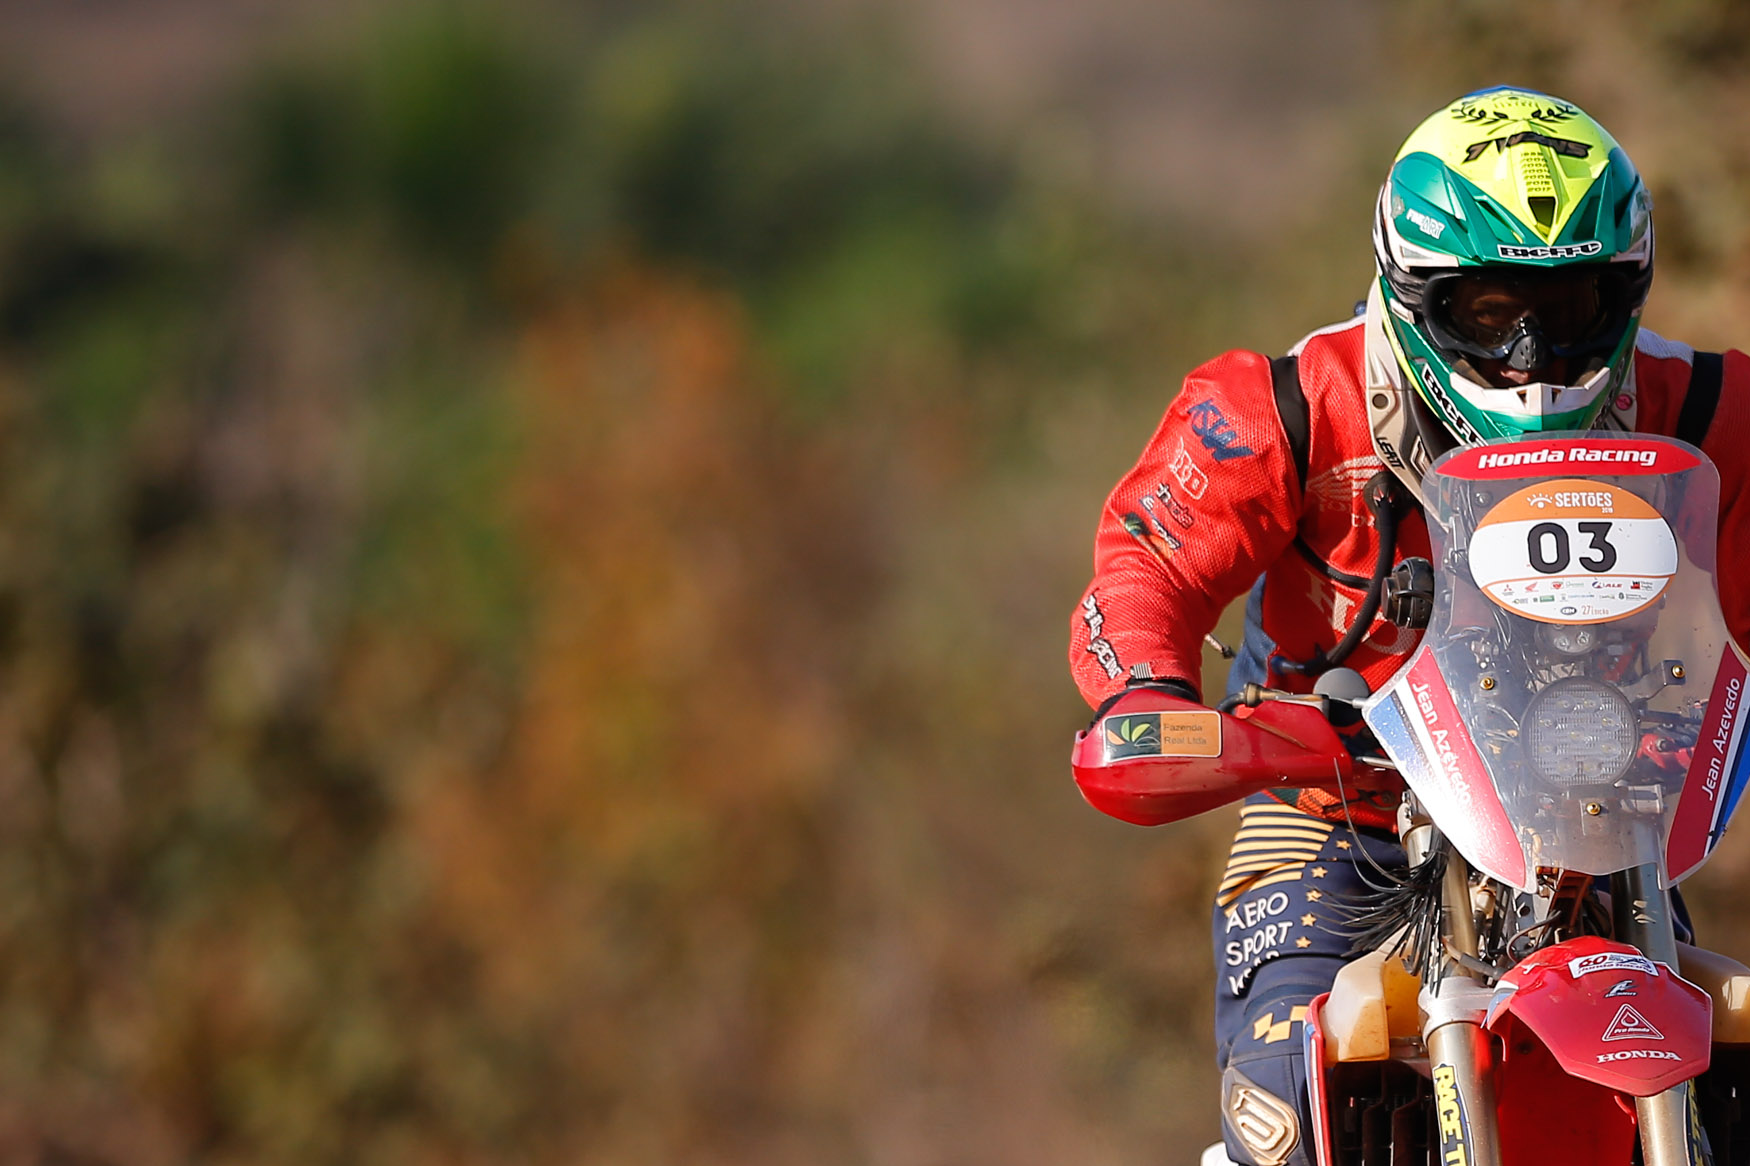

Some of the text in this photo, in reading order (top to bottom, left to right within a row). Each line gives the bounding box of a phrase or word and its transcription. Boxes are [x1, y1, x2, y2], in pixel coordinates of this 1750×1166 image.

[1478, 447, 1657, 469] Honda Racing
[1527, 521, 1618, 574] 03
[1412, 683, 1438, 725] Jean
[1164, 723, 1203, 732] Fazenda
[1164, 736, 1207, 745] Real Ltda
[1702, 678, 1740, 801] Jean Azevedo
[1226, 891, 1290, 935] AERO
[1226, 921, 1294, 967] SPORT
[1597, 1050, 1683, 1064] HONDA
[1434, 1066, 1463, 1144] RACE
